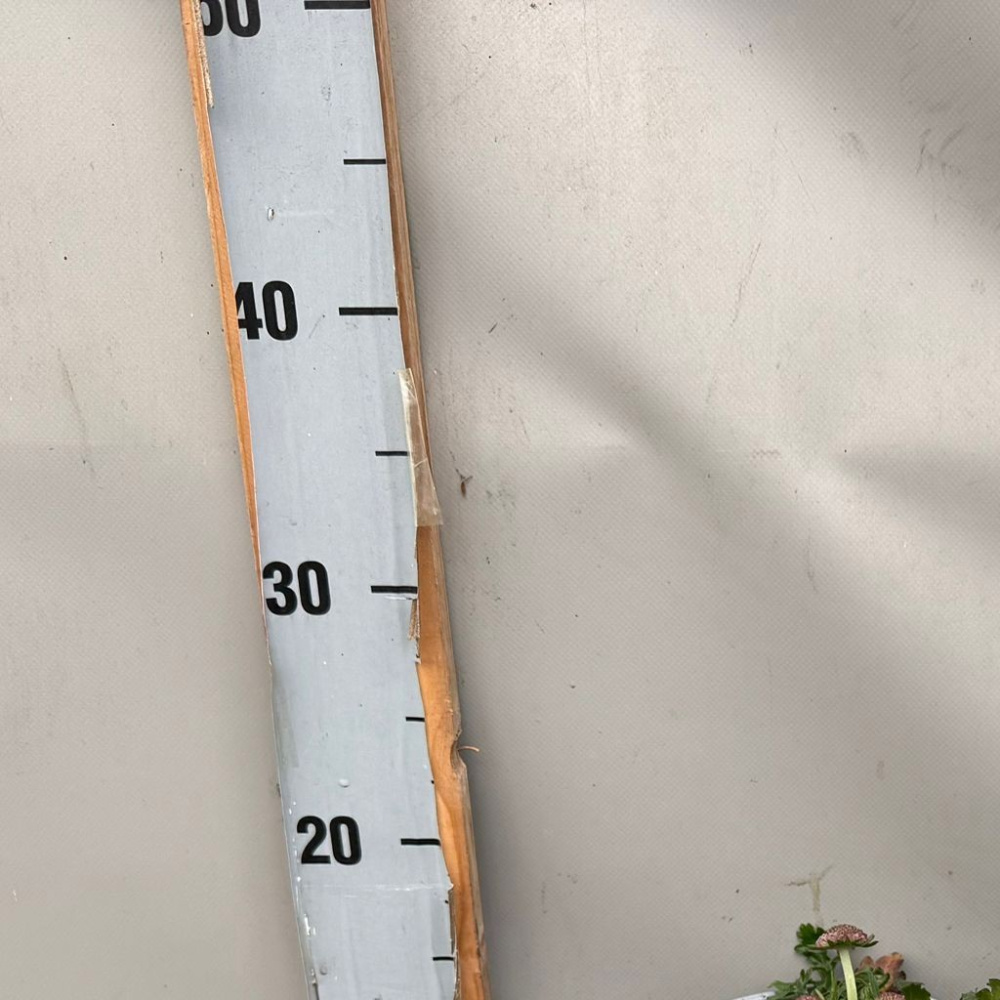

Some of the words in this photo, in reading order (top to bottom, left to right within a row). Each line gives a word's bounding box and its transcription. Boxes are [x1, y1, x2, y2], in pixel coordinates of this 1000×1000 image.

[235, 280, 298, 341] 40
[262, 560, 331, 616] 30
[296, 815, 362, 866] 20
